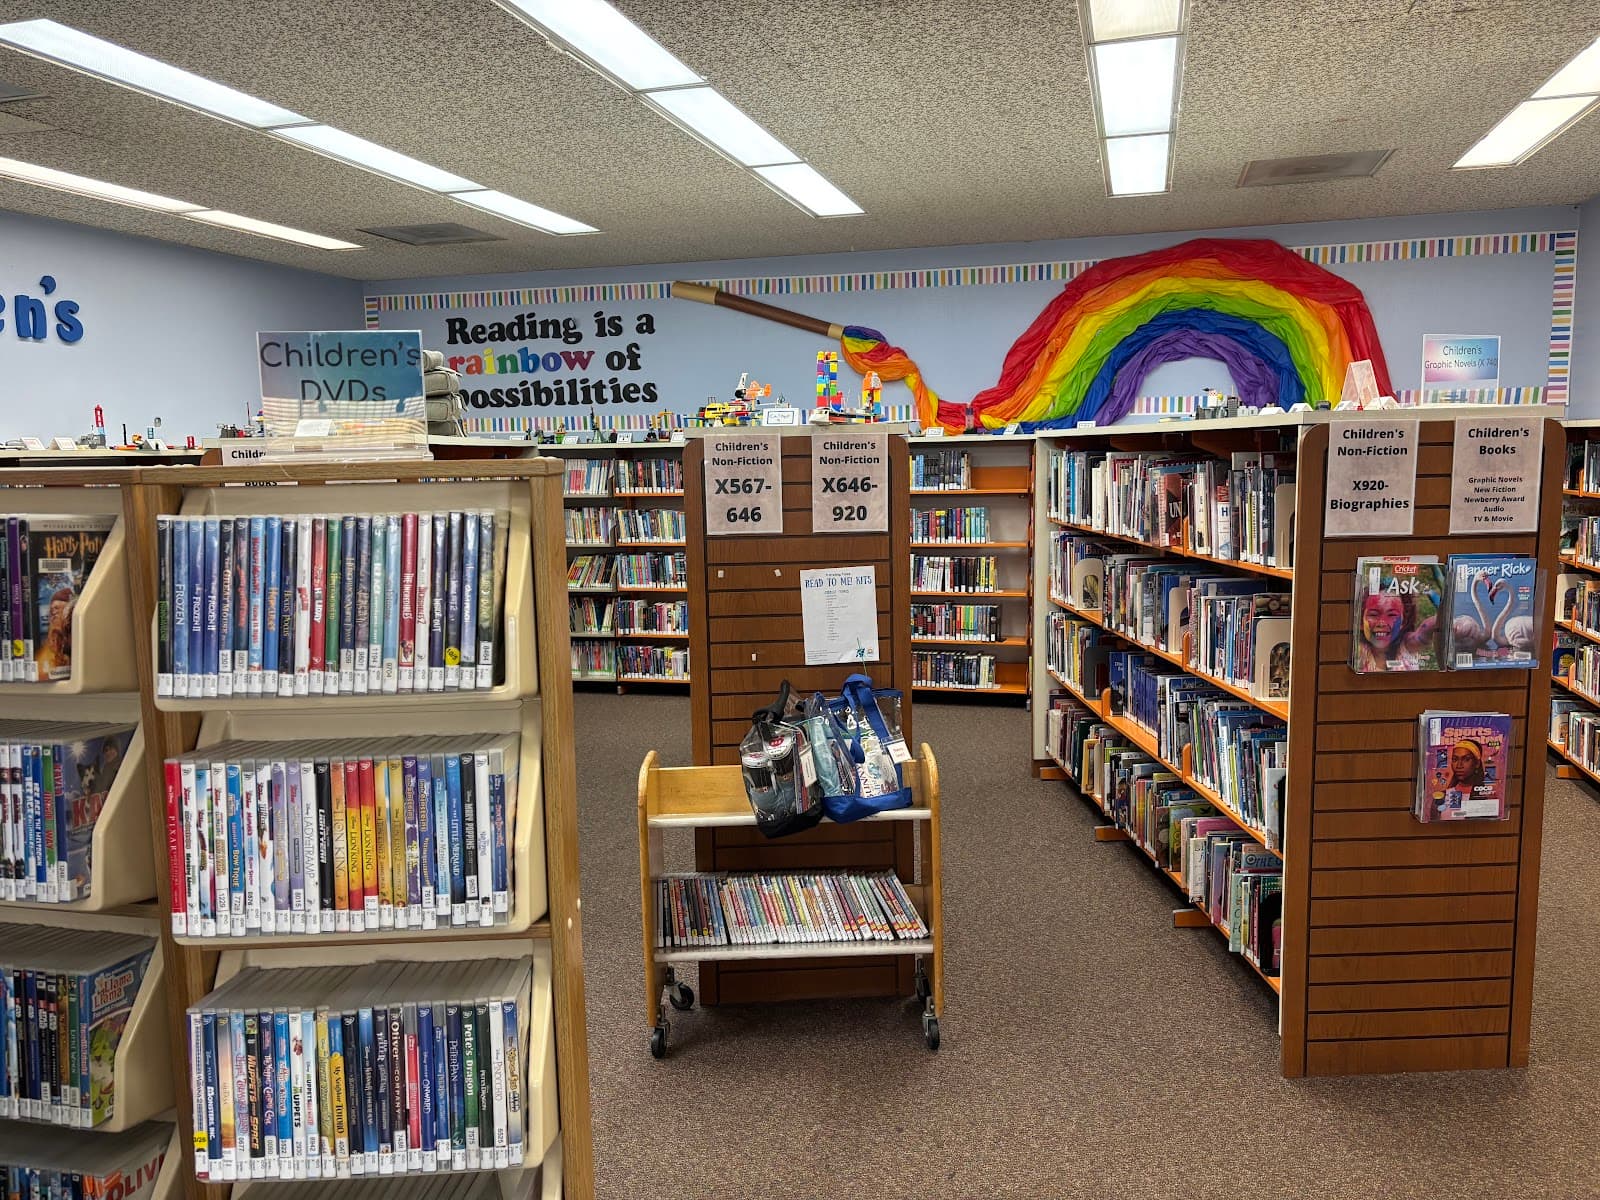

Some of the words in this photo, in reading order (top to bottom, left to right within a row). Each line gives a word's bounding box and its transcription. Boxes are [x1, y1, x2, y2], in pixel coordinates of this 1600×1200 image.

[0, 275, 83, 343] n's
[446, 312, 583, 344] Reading
[594, 311, 623, 337] is
[636, 314, 655, 334] a
[260, 342, 421, 367] Children's
[448, 347, 595, 374] rainbow
[606, 343, 641, 371] of
[1443, 345, 1482, 356] Children's
[1425, 361, 1452, 370] Graphic
[1454, 359, 1476, 368] Novels
[301, 380, 386, 401] DVDs
[1343, 429, 1404, 439] Children's
[1468, 427, 1529, 438] Children's
[715, 442, 768, 451] Children's
[823, 441, 876, 450] Children's
[1337, 446, 1408, 456] Non-Fiction
[1479, 445, 1516, 455] Books
[712, 457, 772, 465] Non-Fiction
[819, 456, 879, 465] Non-Fiction
[715, 478, 772, 494] X567-
[822, 477, 878, 493] X646-
[1352, 480, 1388, 491] X920-
[1468, 476, 1496, 484] Graphic
[1330, 498, 1409, 512] Biographies
[1464, 496, 1500, 504] Newberry
[727, 507, 762, 522] 646
[832, 506, 867, 521] 920
[44, 535, 79, 559] Harry
[1395, 564, 1417, 574] Cricket
[1466, 563, 1499, 576] anger
[1501, 563, 1526, 578] Rick
[222, 569, 231, 602] GREAT
[805, 579, 823, 588] READ
[827, 578, 836, 586] TO
[1387, 577, 1420, 595] Ask
[175, 584, 185, 625] FROZEN
[192, 596, 202, 626] FROZEN
[208, 595, 216, 624] FROZEN
[283, 590, 292, 612] HOCUS
[402, 584, 412, 619] INCREDIBLES
[433, 598, 443, 617] INSIDE
[282, 615, 292, 637] POCUS
[432, 619, 441, 632] OUT
[1444, 727, 1492, 736] Sports
[334, 811, 345, 833] LION
[464, 803, 473, 821] MARY
[168, 816, 176, 851] PIXAR
[304, 816, 313, 839] LADY
[451, 819, 459, 842] LITTLE
[465, 823, 474, 850] POPPINS
[305, 846, 314, 878] TRAMP
[335, 846, 345, 877] KING
[350, 851, 358, 872] KING
[365, 850, 373, 870] KING
[451, 843, 460, 876] MERMAID
[391, 1021, 400, 1060] Oliver
[464, 1024, 474, 1056] Pete's
[448, 1040, 458, 1065] PETER
[248, 1055, 257, 1102] MUPPETS
[333, 1066, 340, 1075] My
[450, 1065, 459, 1081] PAN
[465, 1060, 475, 1096] Dragon
[493, 1061, 502, 1101] PINOCCHIO
[334, 1077, 342, 1103] Neighbor
[422, 1079, 430, 1113] ONWARD
[293, 1086, 301, 1127] MUPPETS
[335, 1104, 345, 1133] TOTORO
[250, 1116, 259, 1150] SPACE
